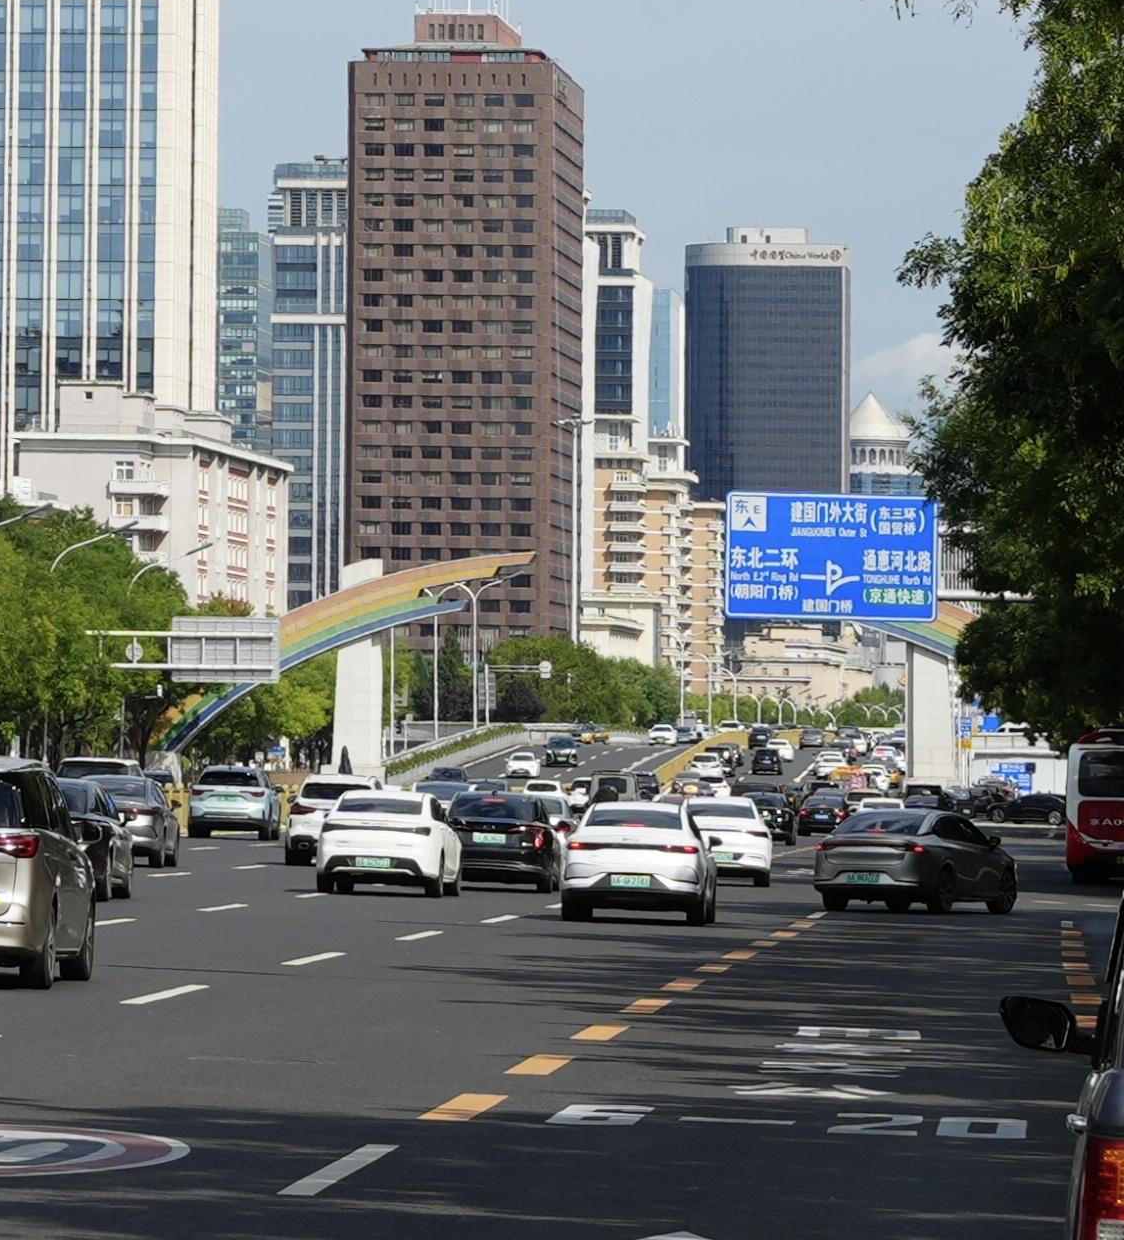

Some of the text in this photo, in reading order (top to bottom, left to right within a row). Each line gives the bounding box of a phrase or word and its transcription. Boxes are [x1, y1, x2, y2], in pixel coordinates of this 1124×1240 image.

[733, 499, 749, 514] 东
[790, 501, 868, 524] 建国门外大街
[730, 545, 800, 571] 东北二环
[862, 548, 932, 573] 通惠河北路
[802, 598, 854, 614] 建国门桥
